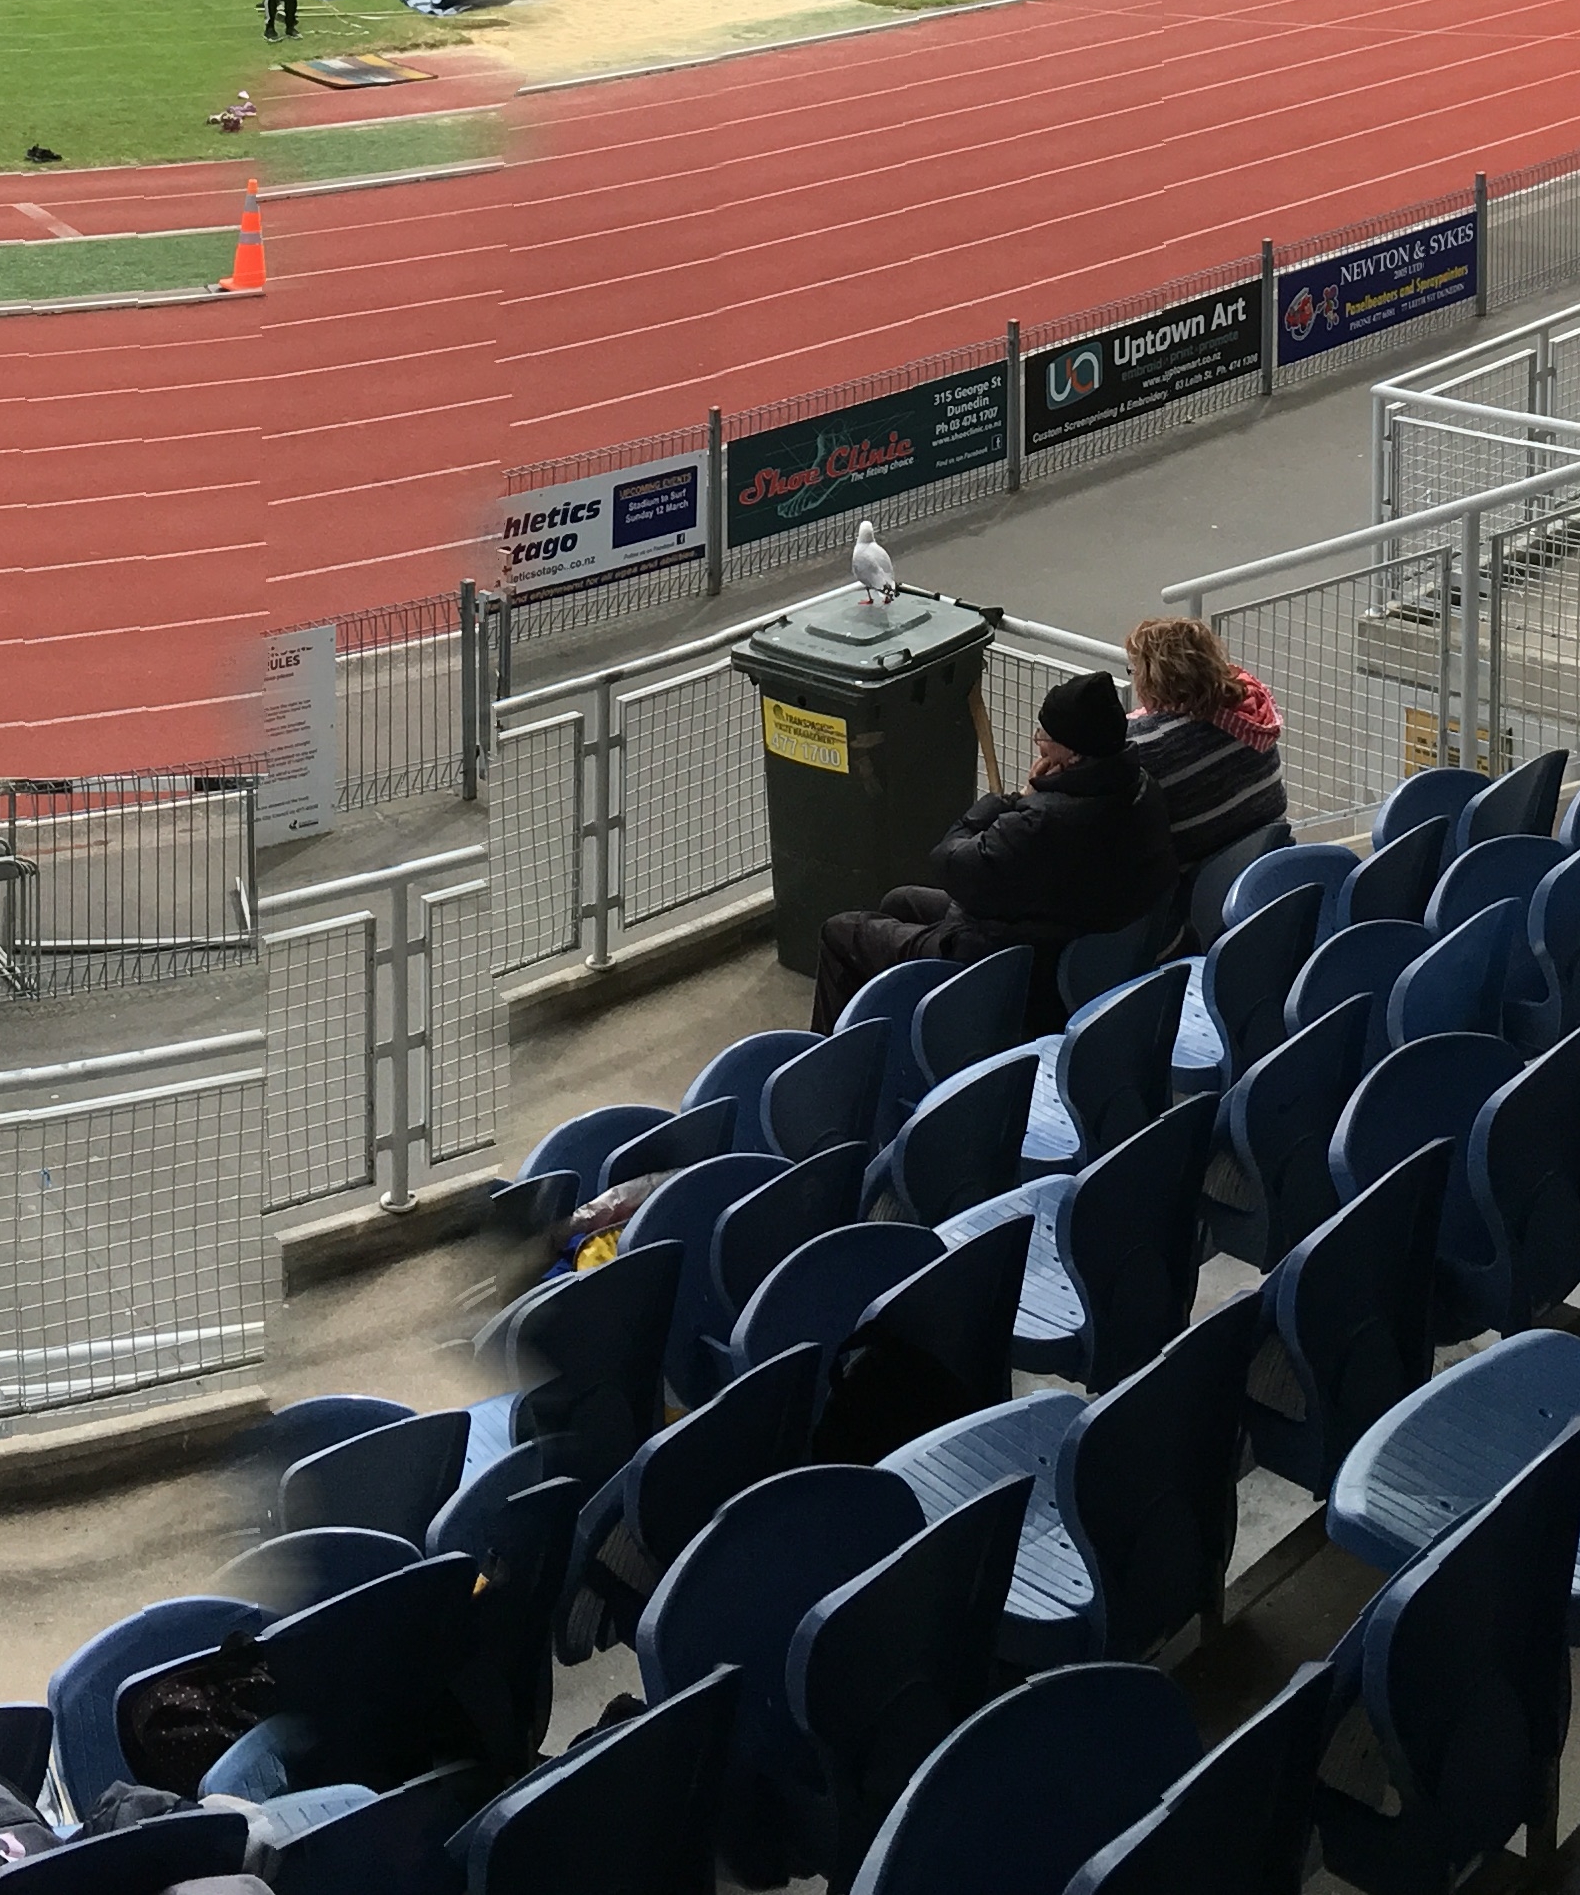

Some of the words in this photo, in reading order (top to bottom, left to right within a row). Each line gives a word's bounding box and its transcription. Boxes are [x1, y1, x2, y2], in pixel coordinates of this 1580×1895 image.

[1340, 244, 1410, 285] NEWTON
[1413, 240, 1426, 260] &
[1429, 223, 1474, 254] SYKES
[1400, 279, 1414, 298] and
[1114, 312, 1205, 366] Uptown
[1211, 297, 1247, 331] Art
[934, 390, 952, 406] 315
[954, 382, 989, 399] George
[991, 376, 1001, 389] St
[935, 422, 948, 435] Ph
[950, 418, 960, 431] 03
[962, 413, 977, 426] 474
[979, 406, 998, 421] 1707
[947, 395, 989, 417] Dunedin
[1032, 426, 1062, 444] Custom
[1064, 407, 1118, 432] Screenprinting
[739, 466, 825, 506] Shoe
[826, 430, 915, 479] Clinic
[851, 472, 864, 483] The
[865, 463, 889, 480] fitting
[890, 455, 915, 471] choice
[620, 480, 661, 499] UPCOMING
[628, 497, 660, 512] Stadium
[661, 494, 669, 503] to
[670, 488, 687, 501] Surf
[625, 509, 654, 523] Sunday
[656, 505, 664, 515] 12
[666, 499, 689, 513] March
[499, 532, 578, 565] tago
[771, 733, 797, 756] 477
[801, 741, 840, 766] 1700
